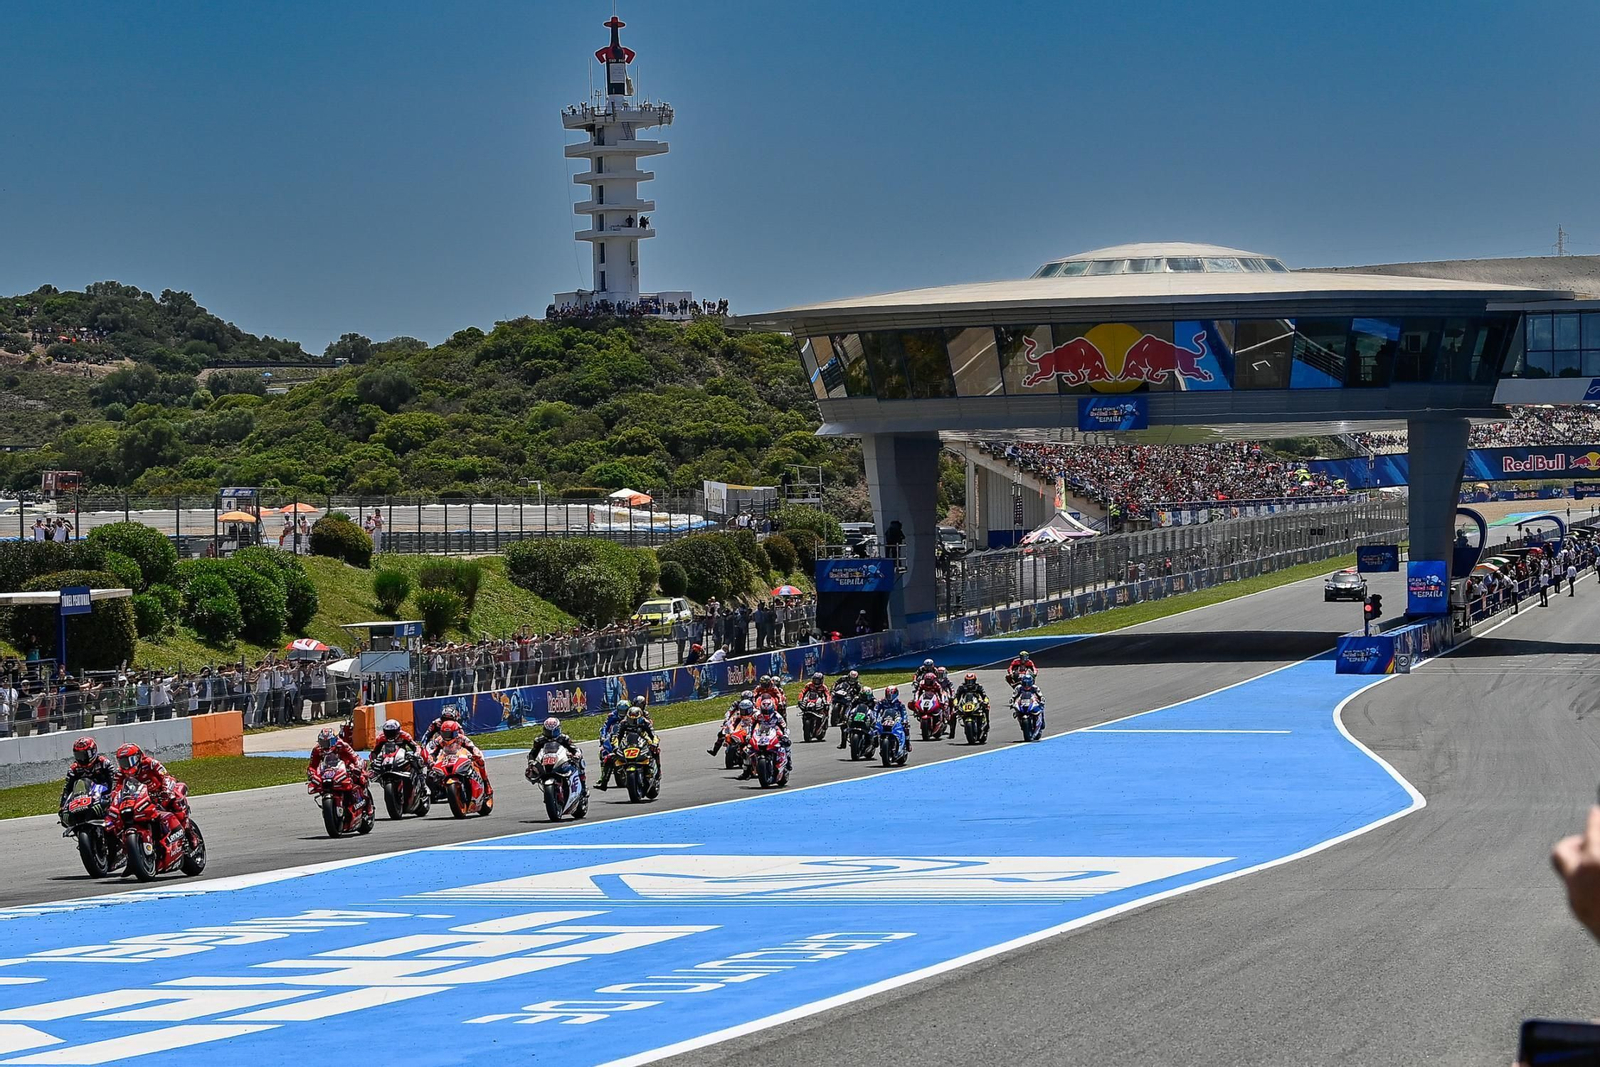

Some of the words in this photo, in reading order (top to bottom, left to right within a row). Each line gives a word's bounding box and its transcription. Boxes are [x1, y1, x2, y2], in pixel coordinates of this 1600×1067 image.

[1503, 455, 1534, 473] Red
[1535, 453, 1566, 471] Bull
[226, 500, 232, 510] 4
[69, 797, 92, 812] 20
[166, 829, 184, 844] Lenovo
[594, 932, 917, 994] CIRCUITO
[461, 1001, 664, 1024] DE
